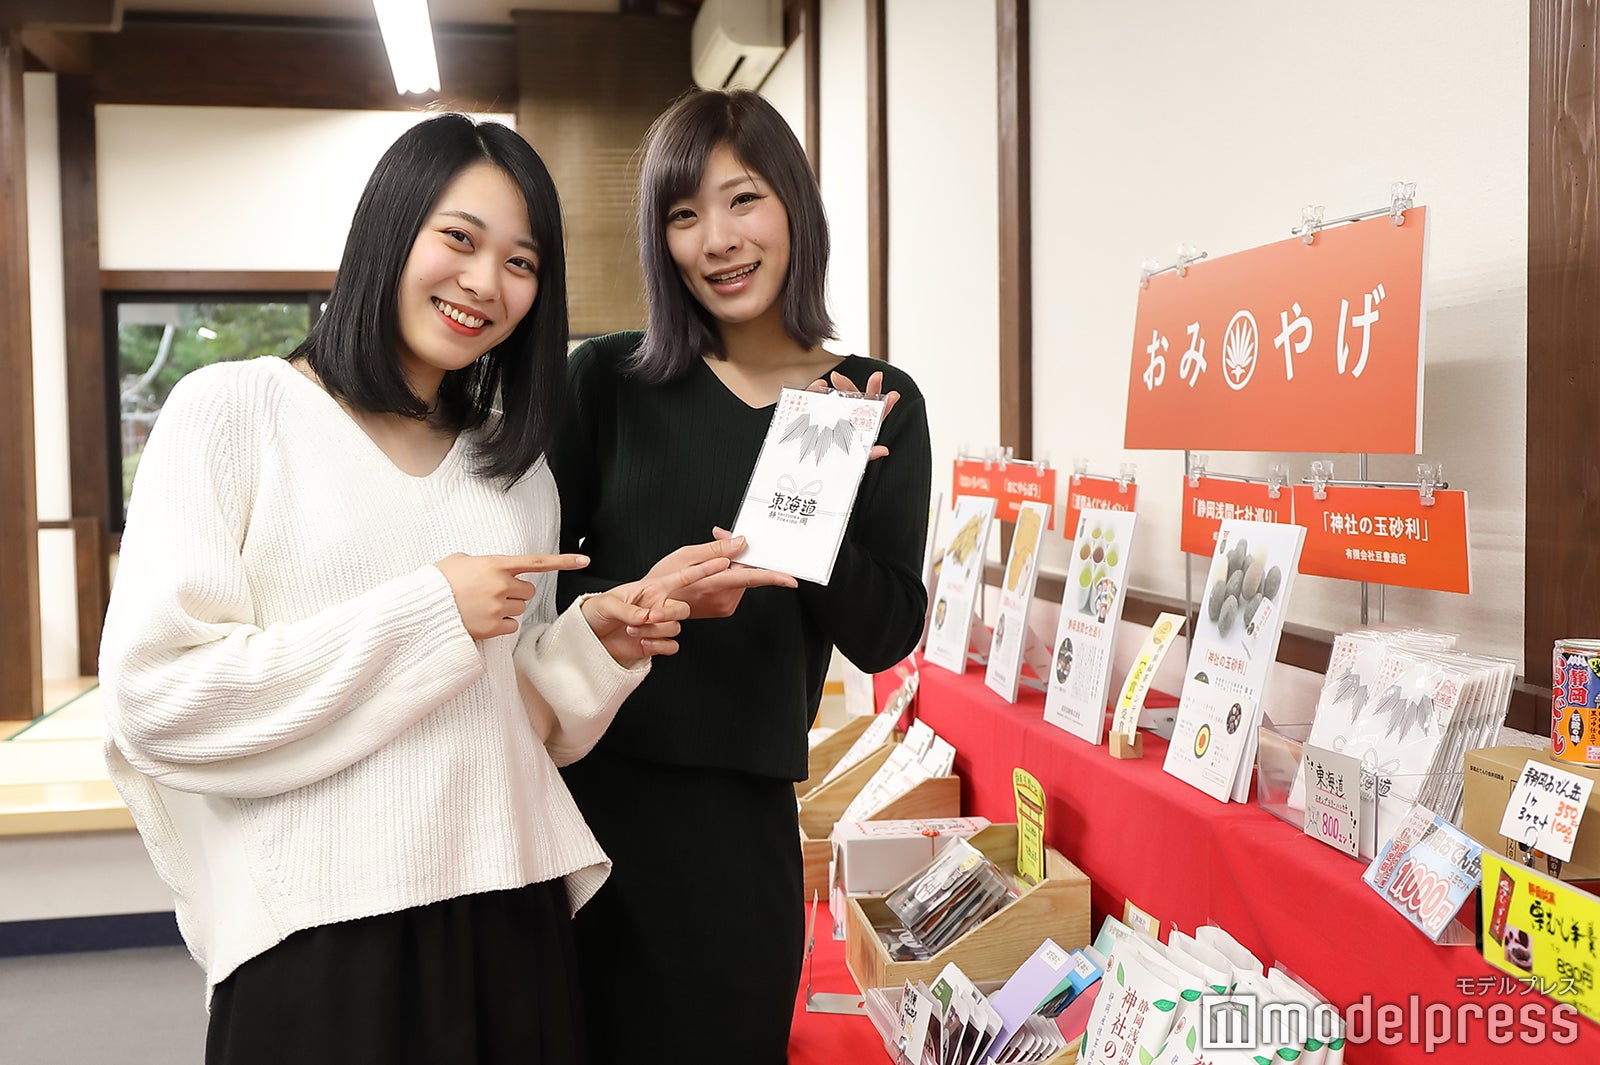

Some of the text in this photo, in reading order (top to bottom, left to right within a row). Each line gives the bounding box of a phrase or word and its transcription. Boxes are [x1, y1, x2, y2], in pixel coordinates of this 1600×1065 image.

[768, 492, 817, 517] 東海道
[1323, 511, 1429, 542] 「神社の玉砂利」
[1568, 668, 1589, 704] 静岡
[1099, 986, 1138, 1065] 神社の
